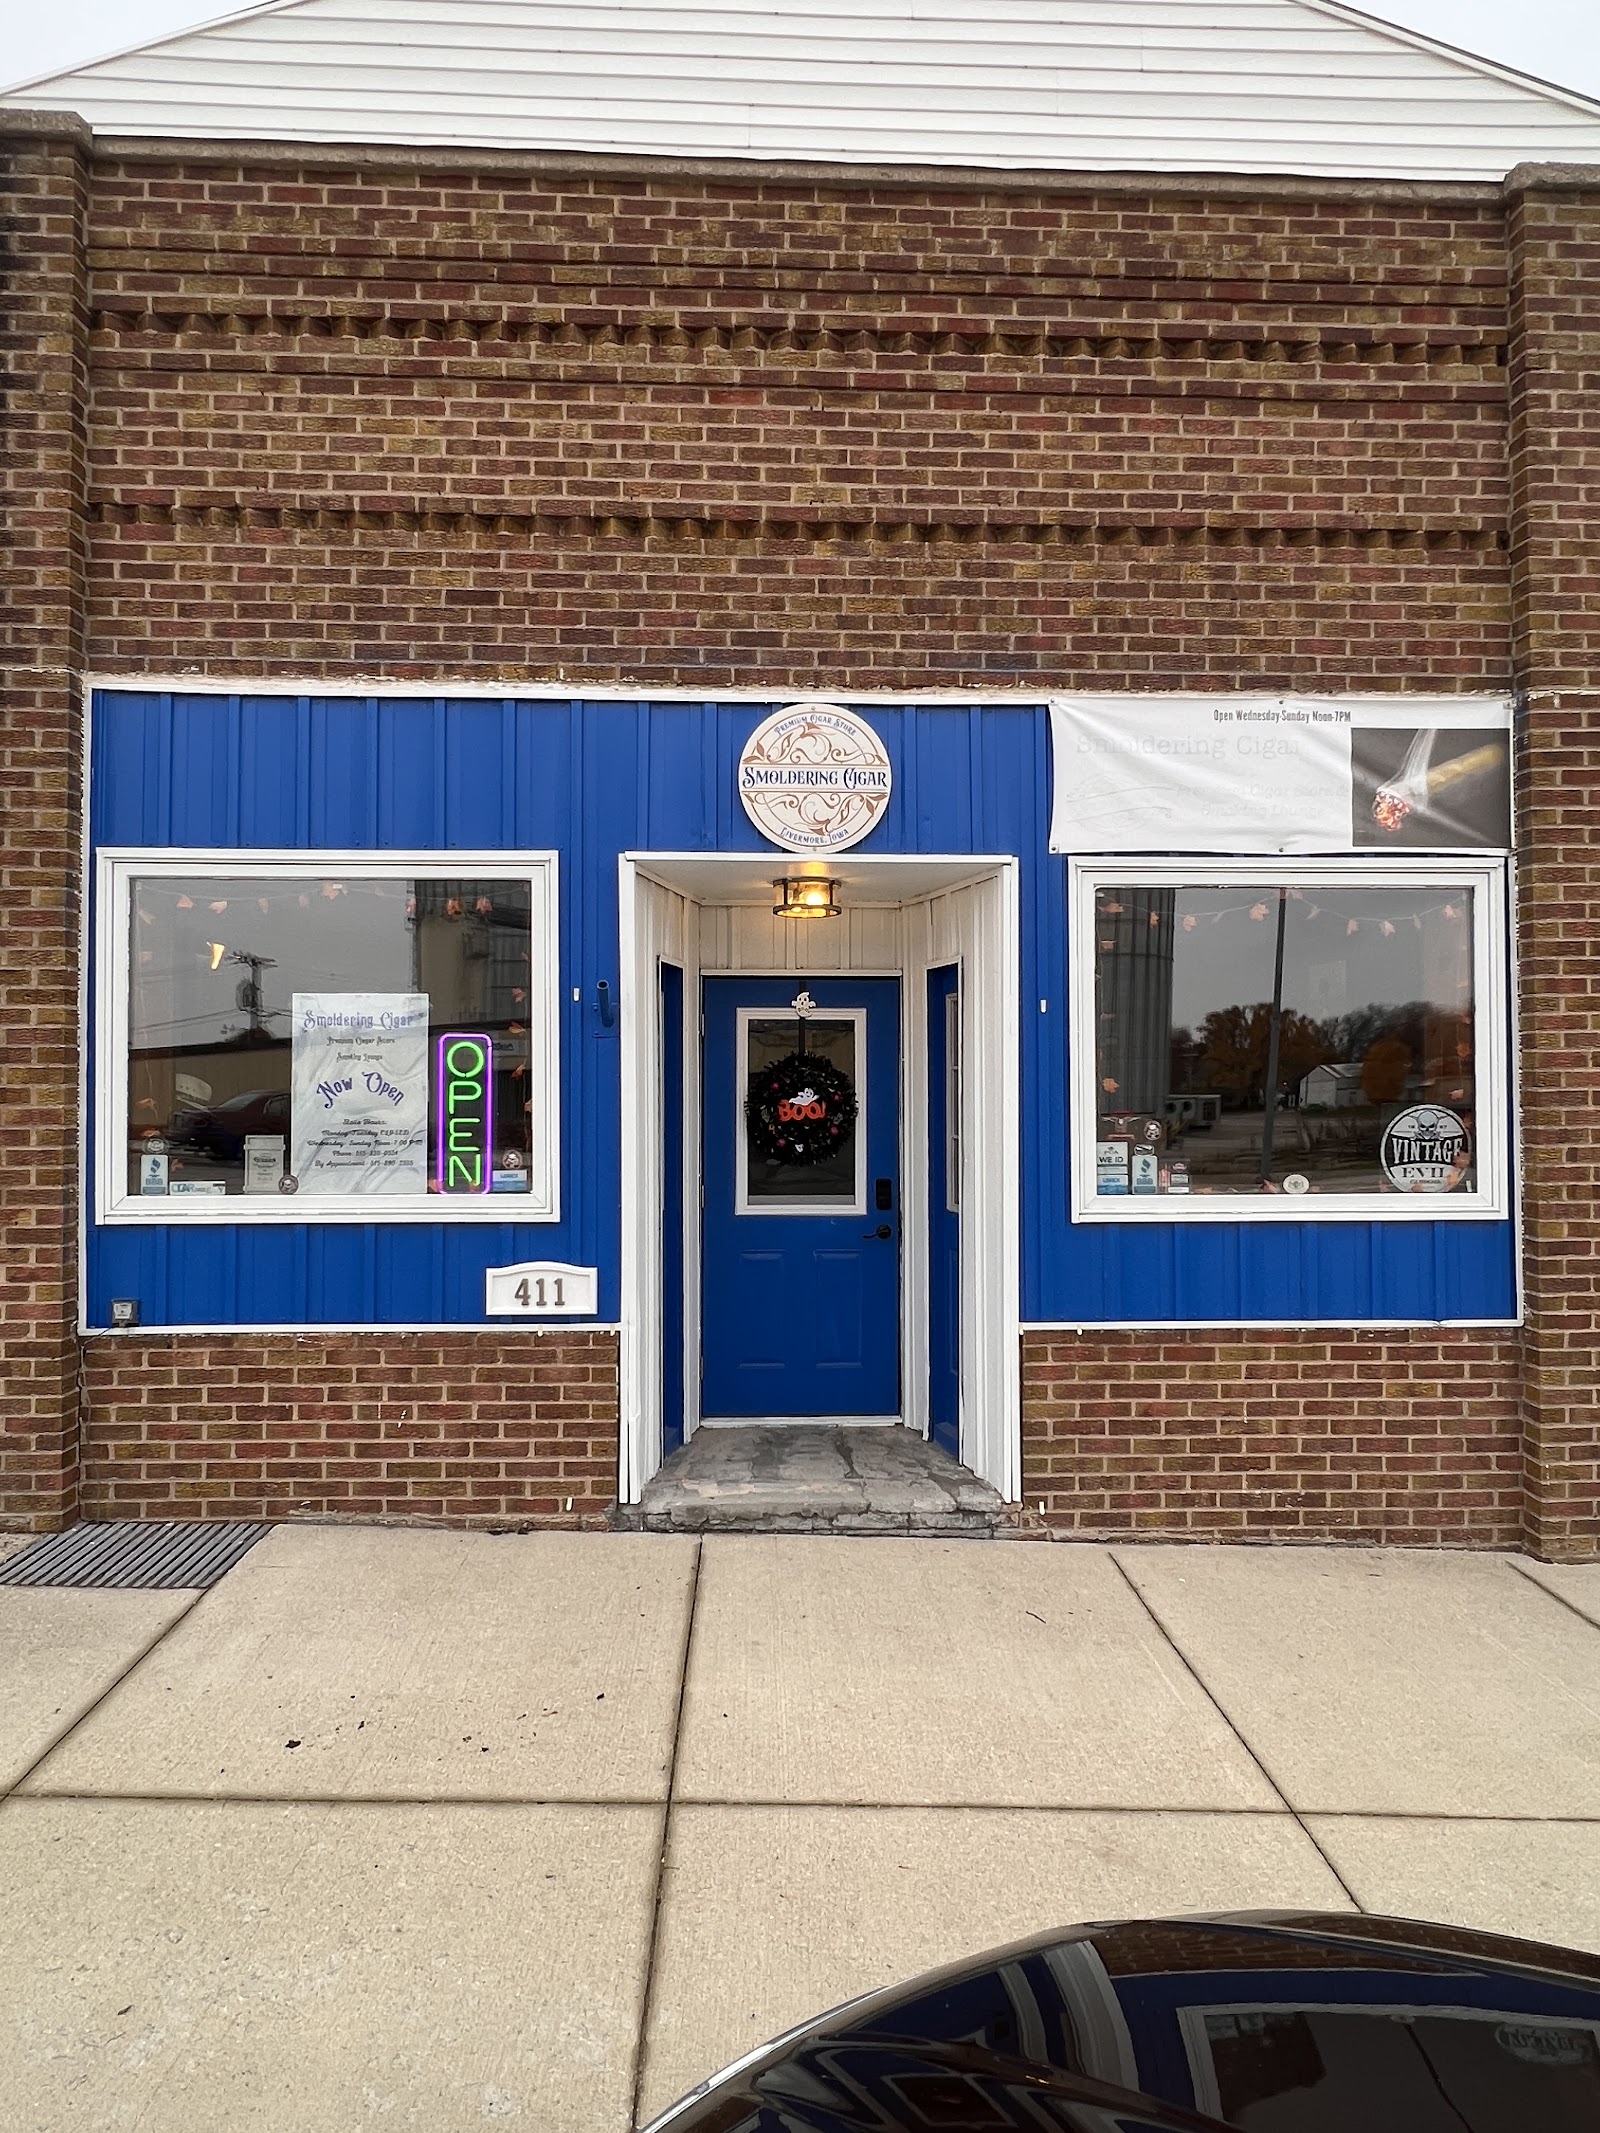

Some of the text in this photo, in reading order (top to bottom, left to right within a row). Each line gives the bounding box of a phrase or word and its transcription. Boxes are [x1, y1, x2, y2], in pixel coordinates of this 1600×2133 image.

[774, 714, 857, 737] PREMIUM CIGAR STORE
[1213, 709, 1351, 724] Open Wednesday-Sunday Noon-7PM
[742, 767, 888, 789] SMOLDERING CIGAR
[828, 828, 850, 844] IOWA
[304, 1009, 414, 1030] Smoldering Cigar
[316, 1071, 404, 1109] Now Open
[446, 1041, 485, 1188] OPEN
[1391, 1137, 1463, 1164] VINTAGE
[514, 1278, 565, 1306] 411
